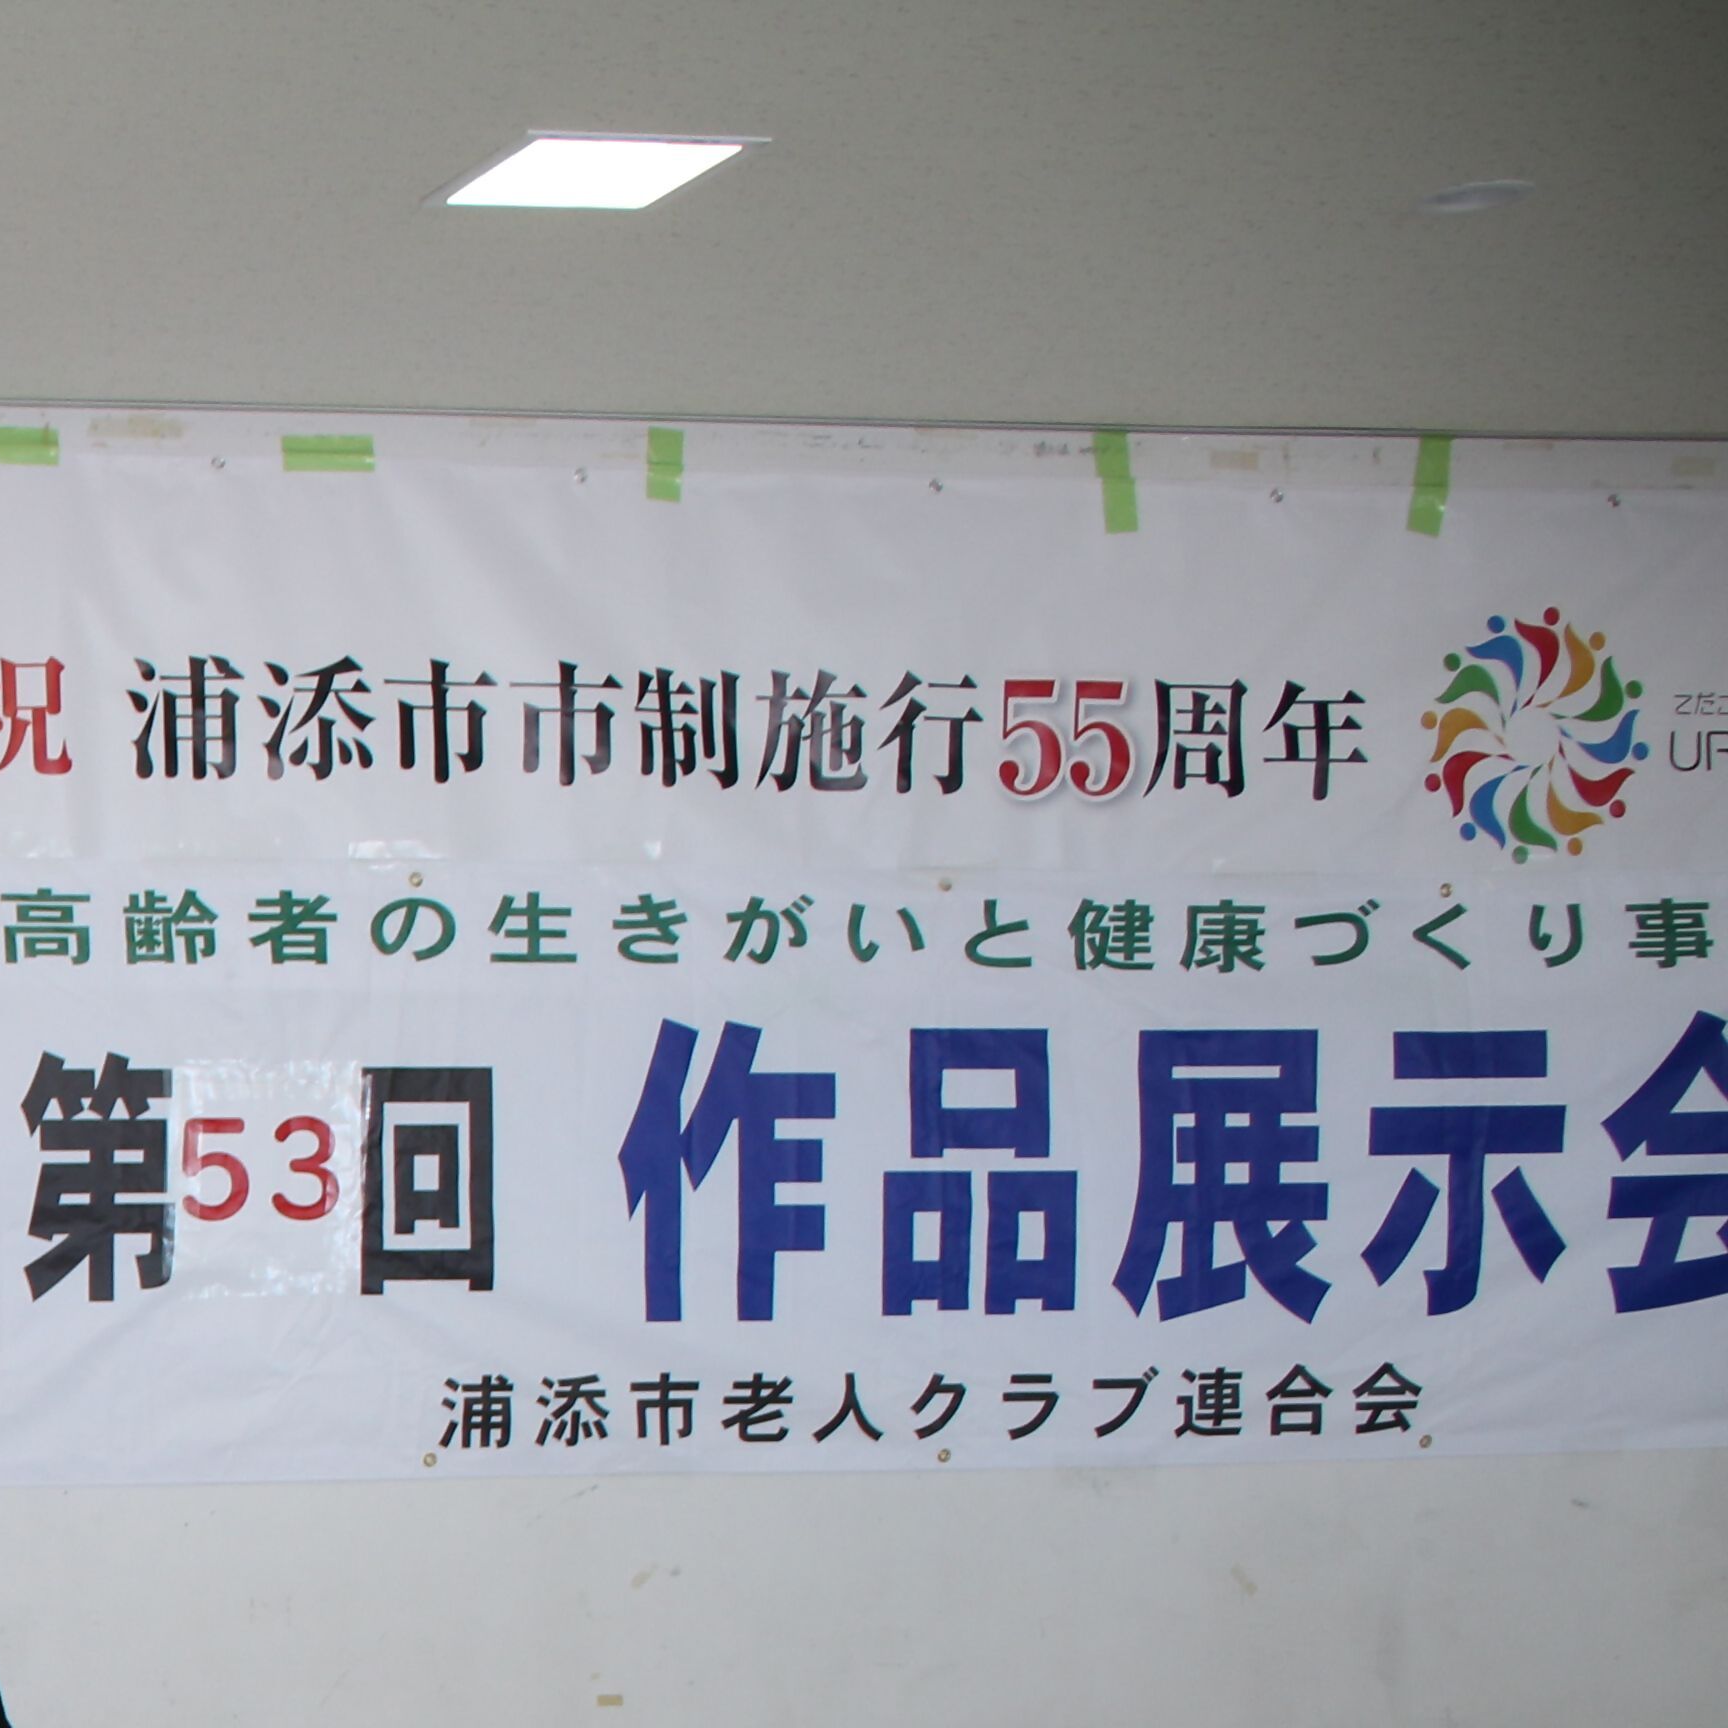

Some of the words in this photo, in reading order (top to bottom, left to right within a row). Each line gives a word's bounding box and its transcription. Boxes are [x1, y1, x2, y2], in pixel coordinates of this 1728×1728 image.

[125, 654, 1371, 801] 浦添市市制施行55周年
[0, 889, 1716, 974] 高齢者の生きがいと健康づくり事
[18, 1050, 496, 1304] 第53回
[616, 1008, 1728, 1328] 作品展示会
[434, 1360, 1426, 1452] 浦添市老人クラブ連合会
